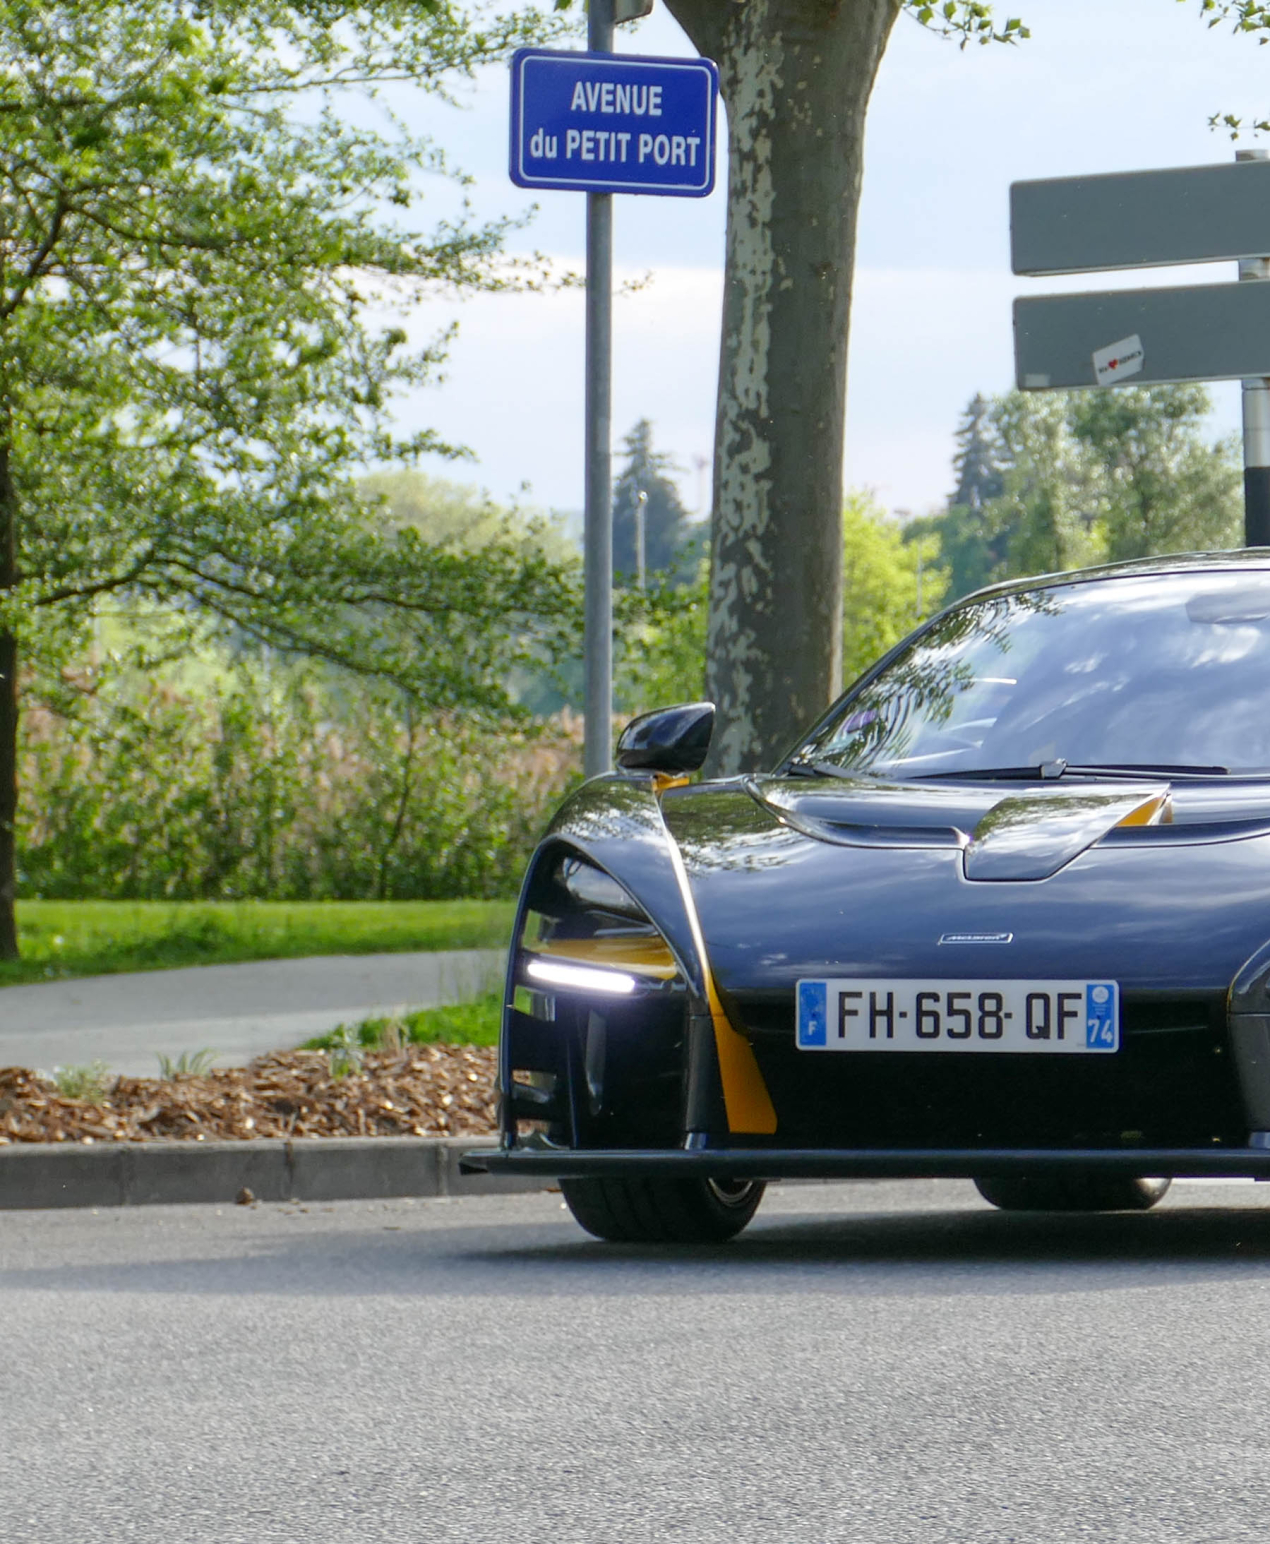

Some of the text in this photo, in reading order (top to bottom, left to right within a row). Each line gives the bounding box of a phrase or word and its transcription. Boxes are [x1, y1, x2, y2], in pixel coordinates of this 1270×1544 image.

[571, 81, 662, 116] AVENUE
[530, 127, 701, 167] du PETIT PORT
[808, 1021, 817, 1036] F
[838, 991, 1082, 1040] FH-658-QF
[1088, 1018, 1113, 1043] 74
